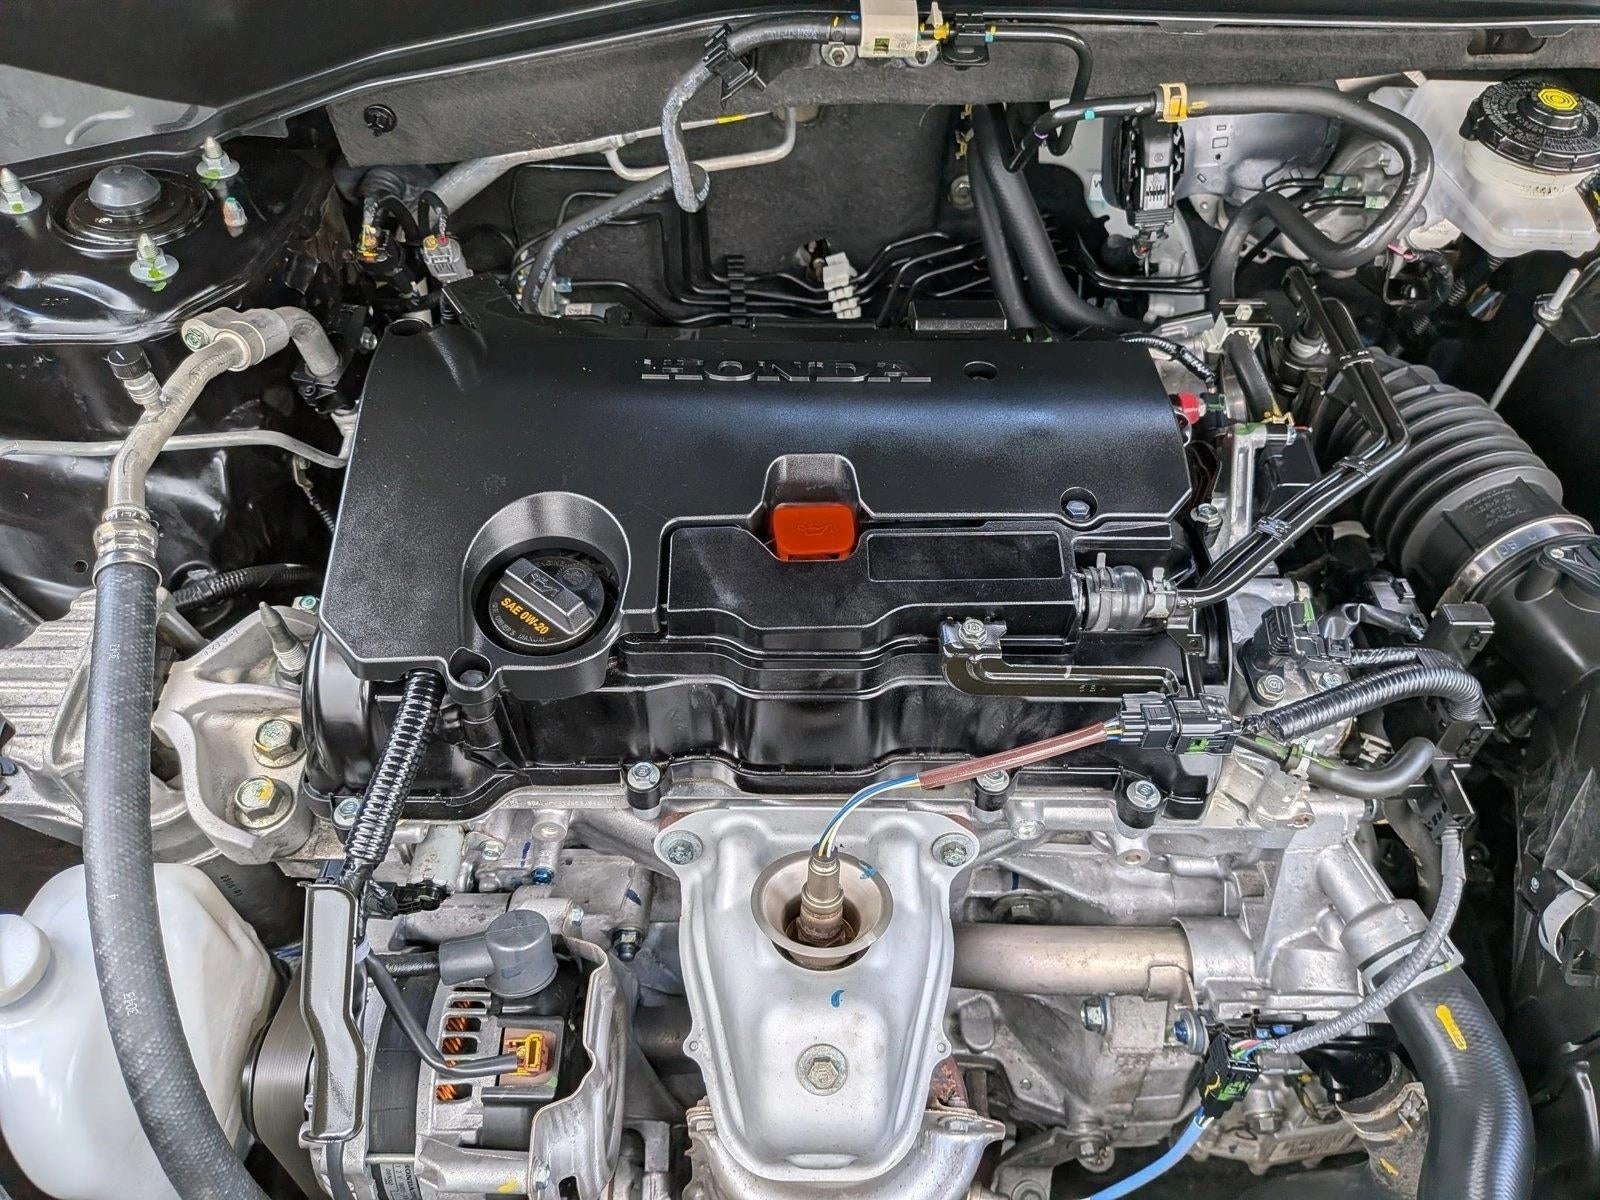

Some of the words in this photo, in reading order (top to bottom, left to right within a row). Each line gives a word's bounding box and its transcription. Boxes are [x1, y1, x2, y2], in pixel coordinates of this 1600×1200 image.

[640, 357, 932, 383] HONDA
[500, 597, 523, 615] SAE
[519, 611, 549, 635] 0W-20
